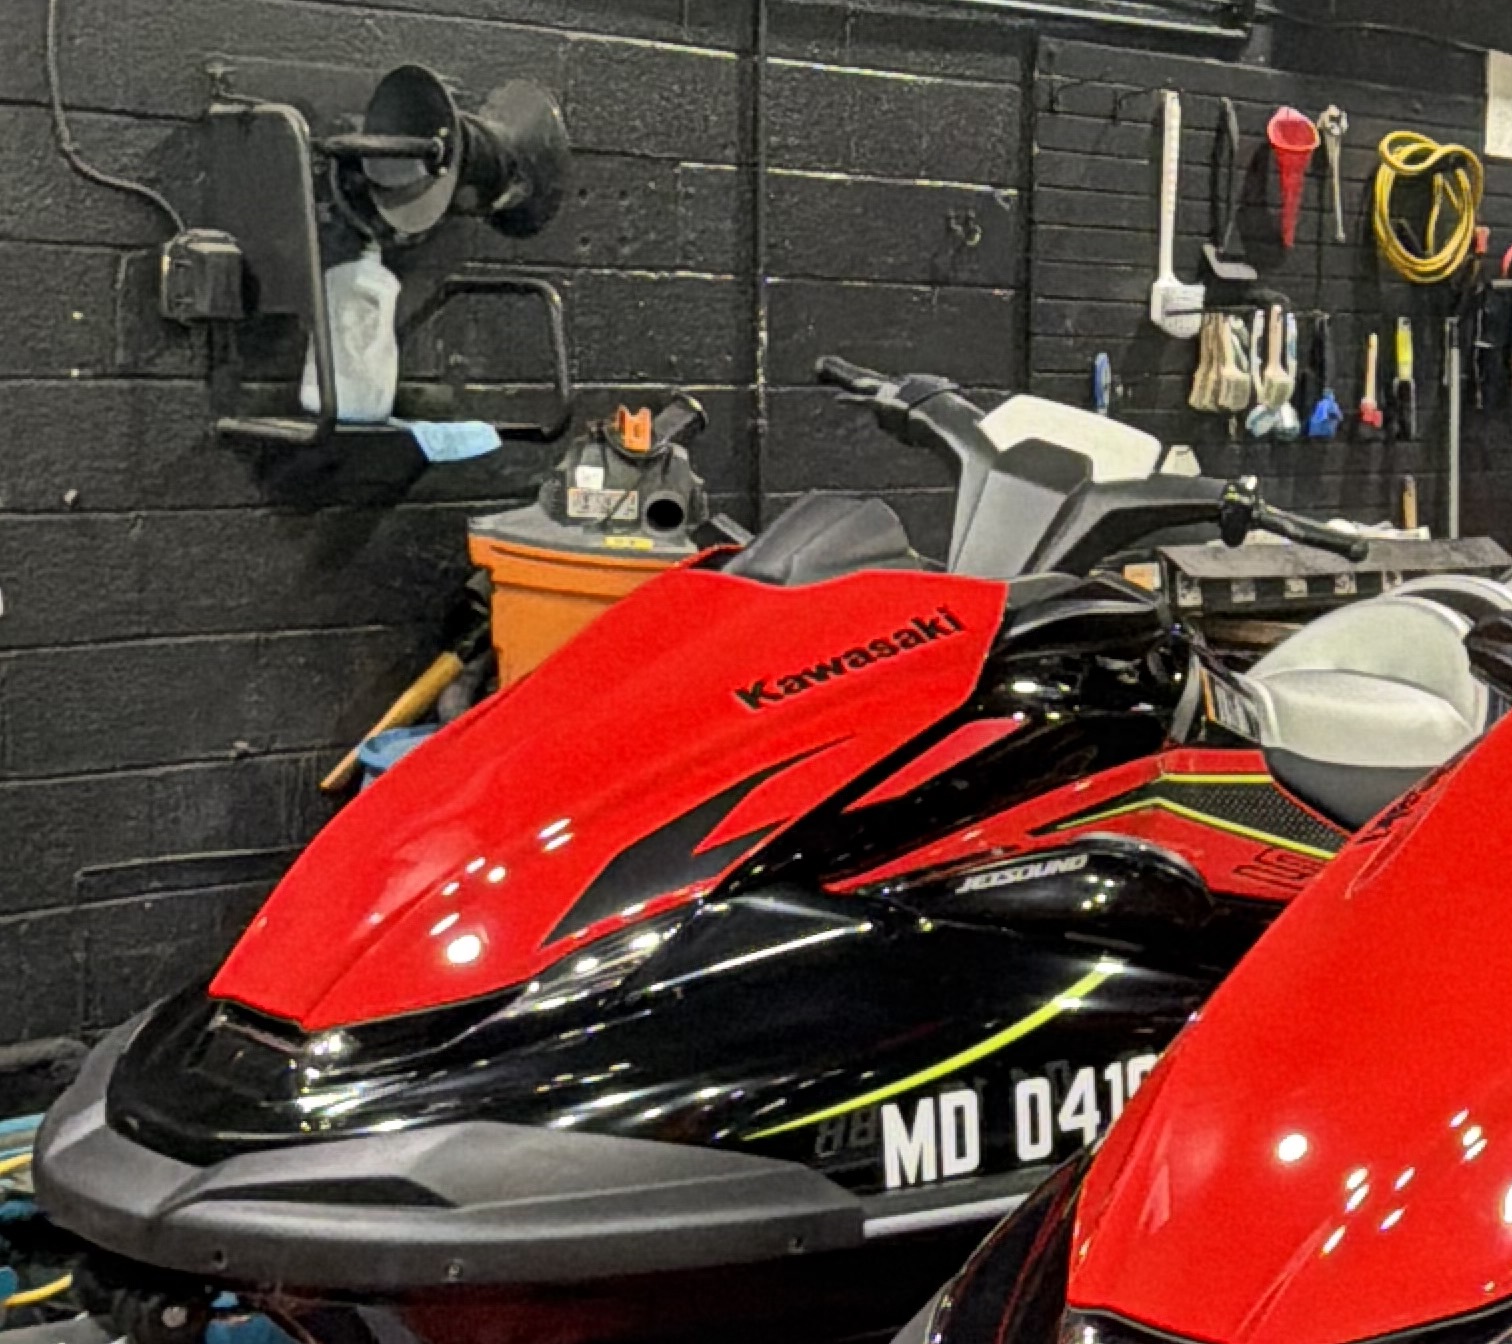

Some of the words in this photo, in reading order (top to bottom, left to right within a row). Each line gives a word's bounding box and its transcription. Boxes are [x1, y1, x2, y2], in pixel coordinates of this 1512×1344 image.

[734, 605, 965, 710] Kawasaki
[954, 853, 1089, 895] JETSOUND
[881, 1088, 981, 1189] MD
